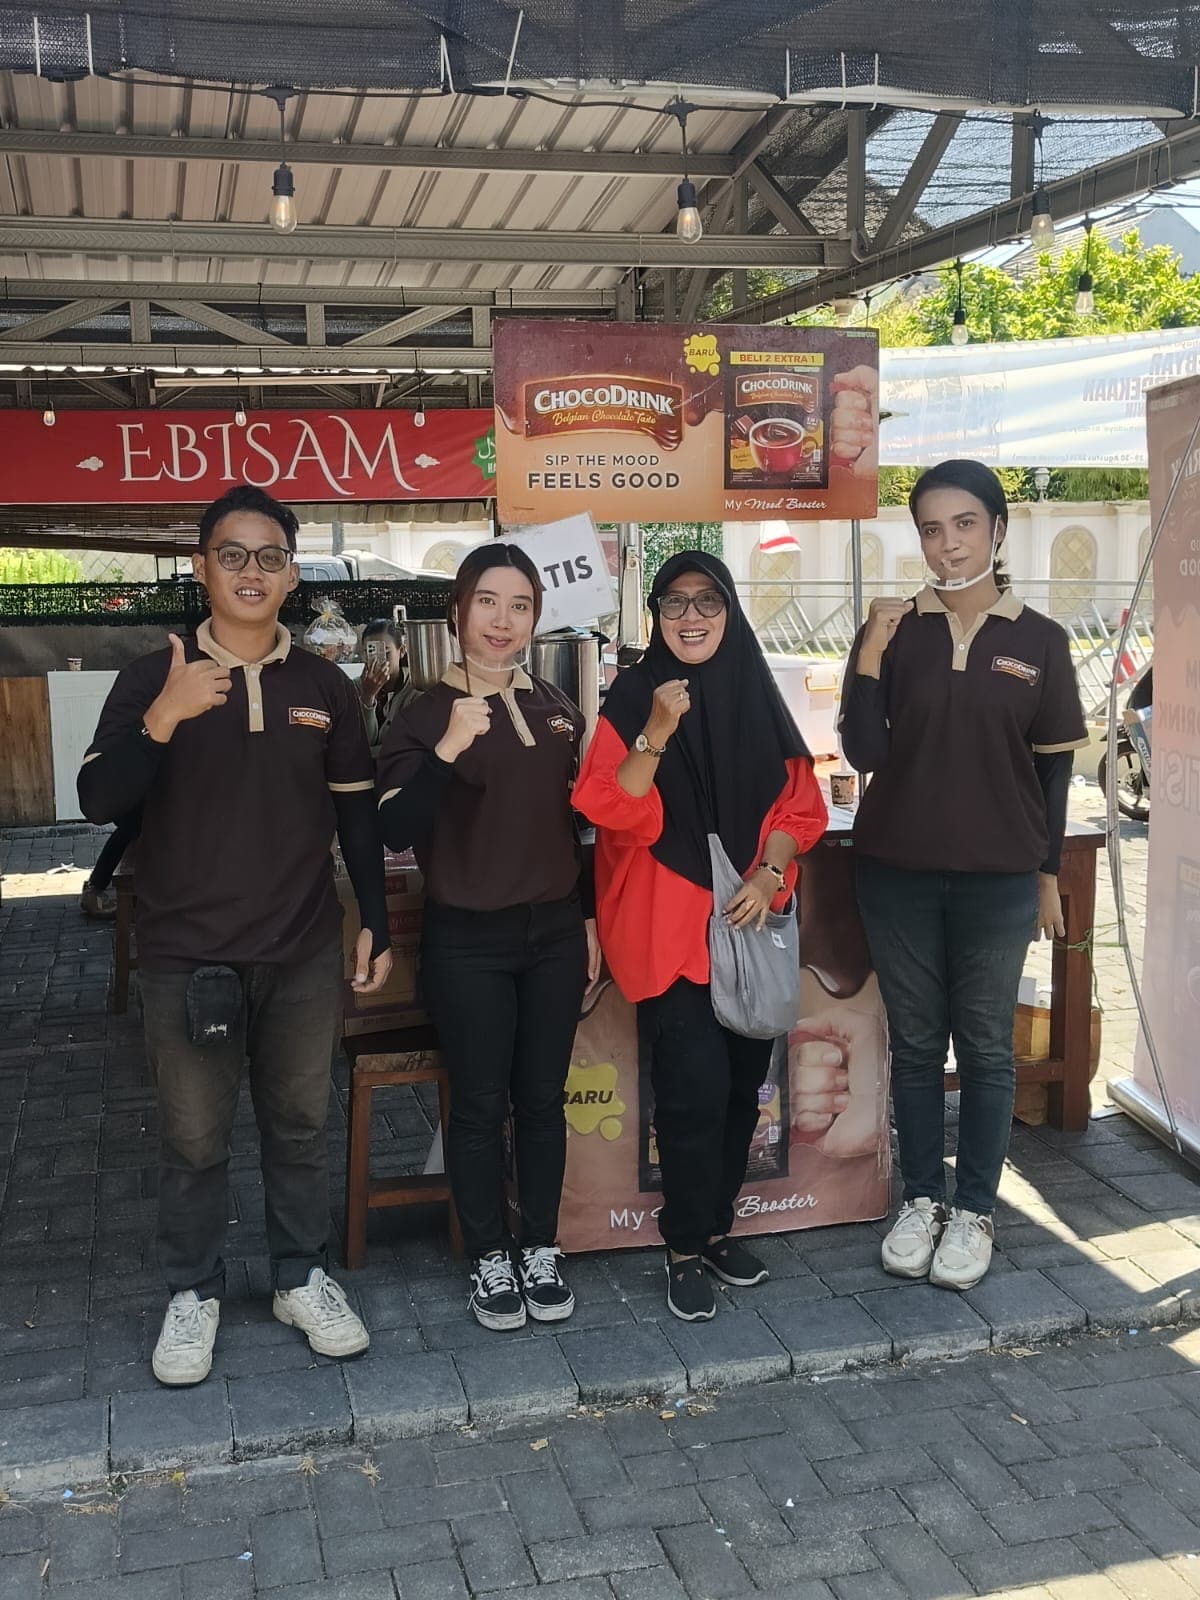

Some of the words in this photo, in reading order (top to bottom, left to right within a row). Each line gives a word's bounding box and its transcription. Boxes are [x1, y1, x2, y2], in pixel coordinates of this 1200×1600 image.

[688, 347, 716, 358] BARU
[739, 354, 763, 363] BELI
[765, 354, 772, 363] 2
[774, 355, 808, 364] EXTRA
[810, 356, 816, 364] 1
[551, 410, 590, 427] Belgian
[591, 408, 635, 424] Chocolate
[633, 410, 658, 425] Taste
[545, 454, 571, 466] SIP
[575, 454, 606, 466] THE
[612, 454, 660, 466] MOOD
[528, 473, 602, 489] FEELS
[611, 472, 680, 489] GOOD
[724, 499, 742, 511] My
[744, 497, 784, 510] Mood
[785, 498, 828, 510] Booster
[541, 554, 594, 592] TIS
[609, 1207, 645, 1231] My
[737, 1193, 819, 1218] Booster
